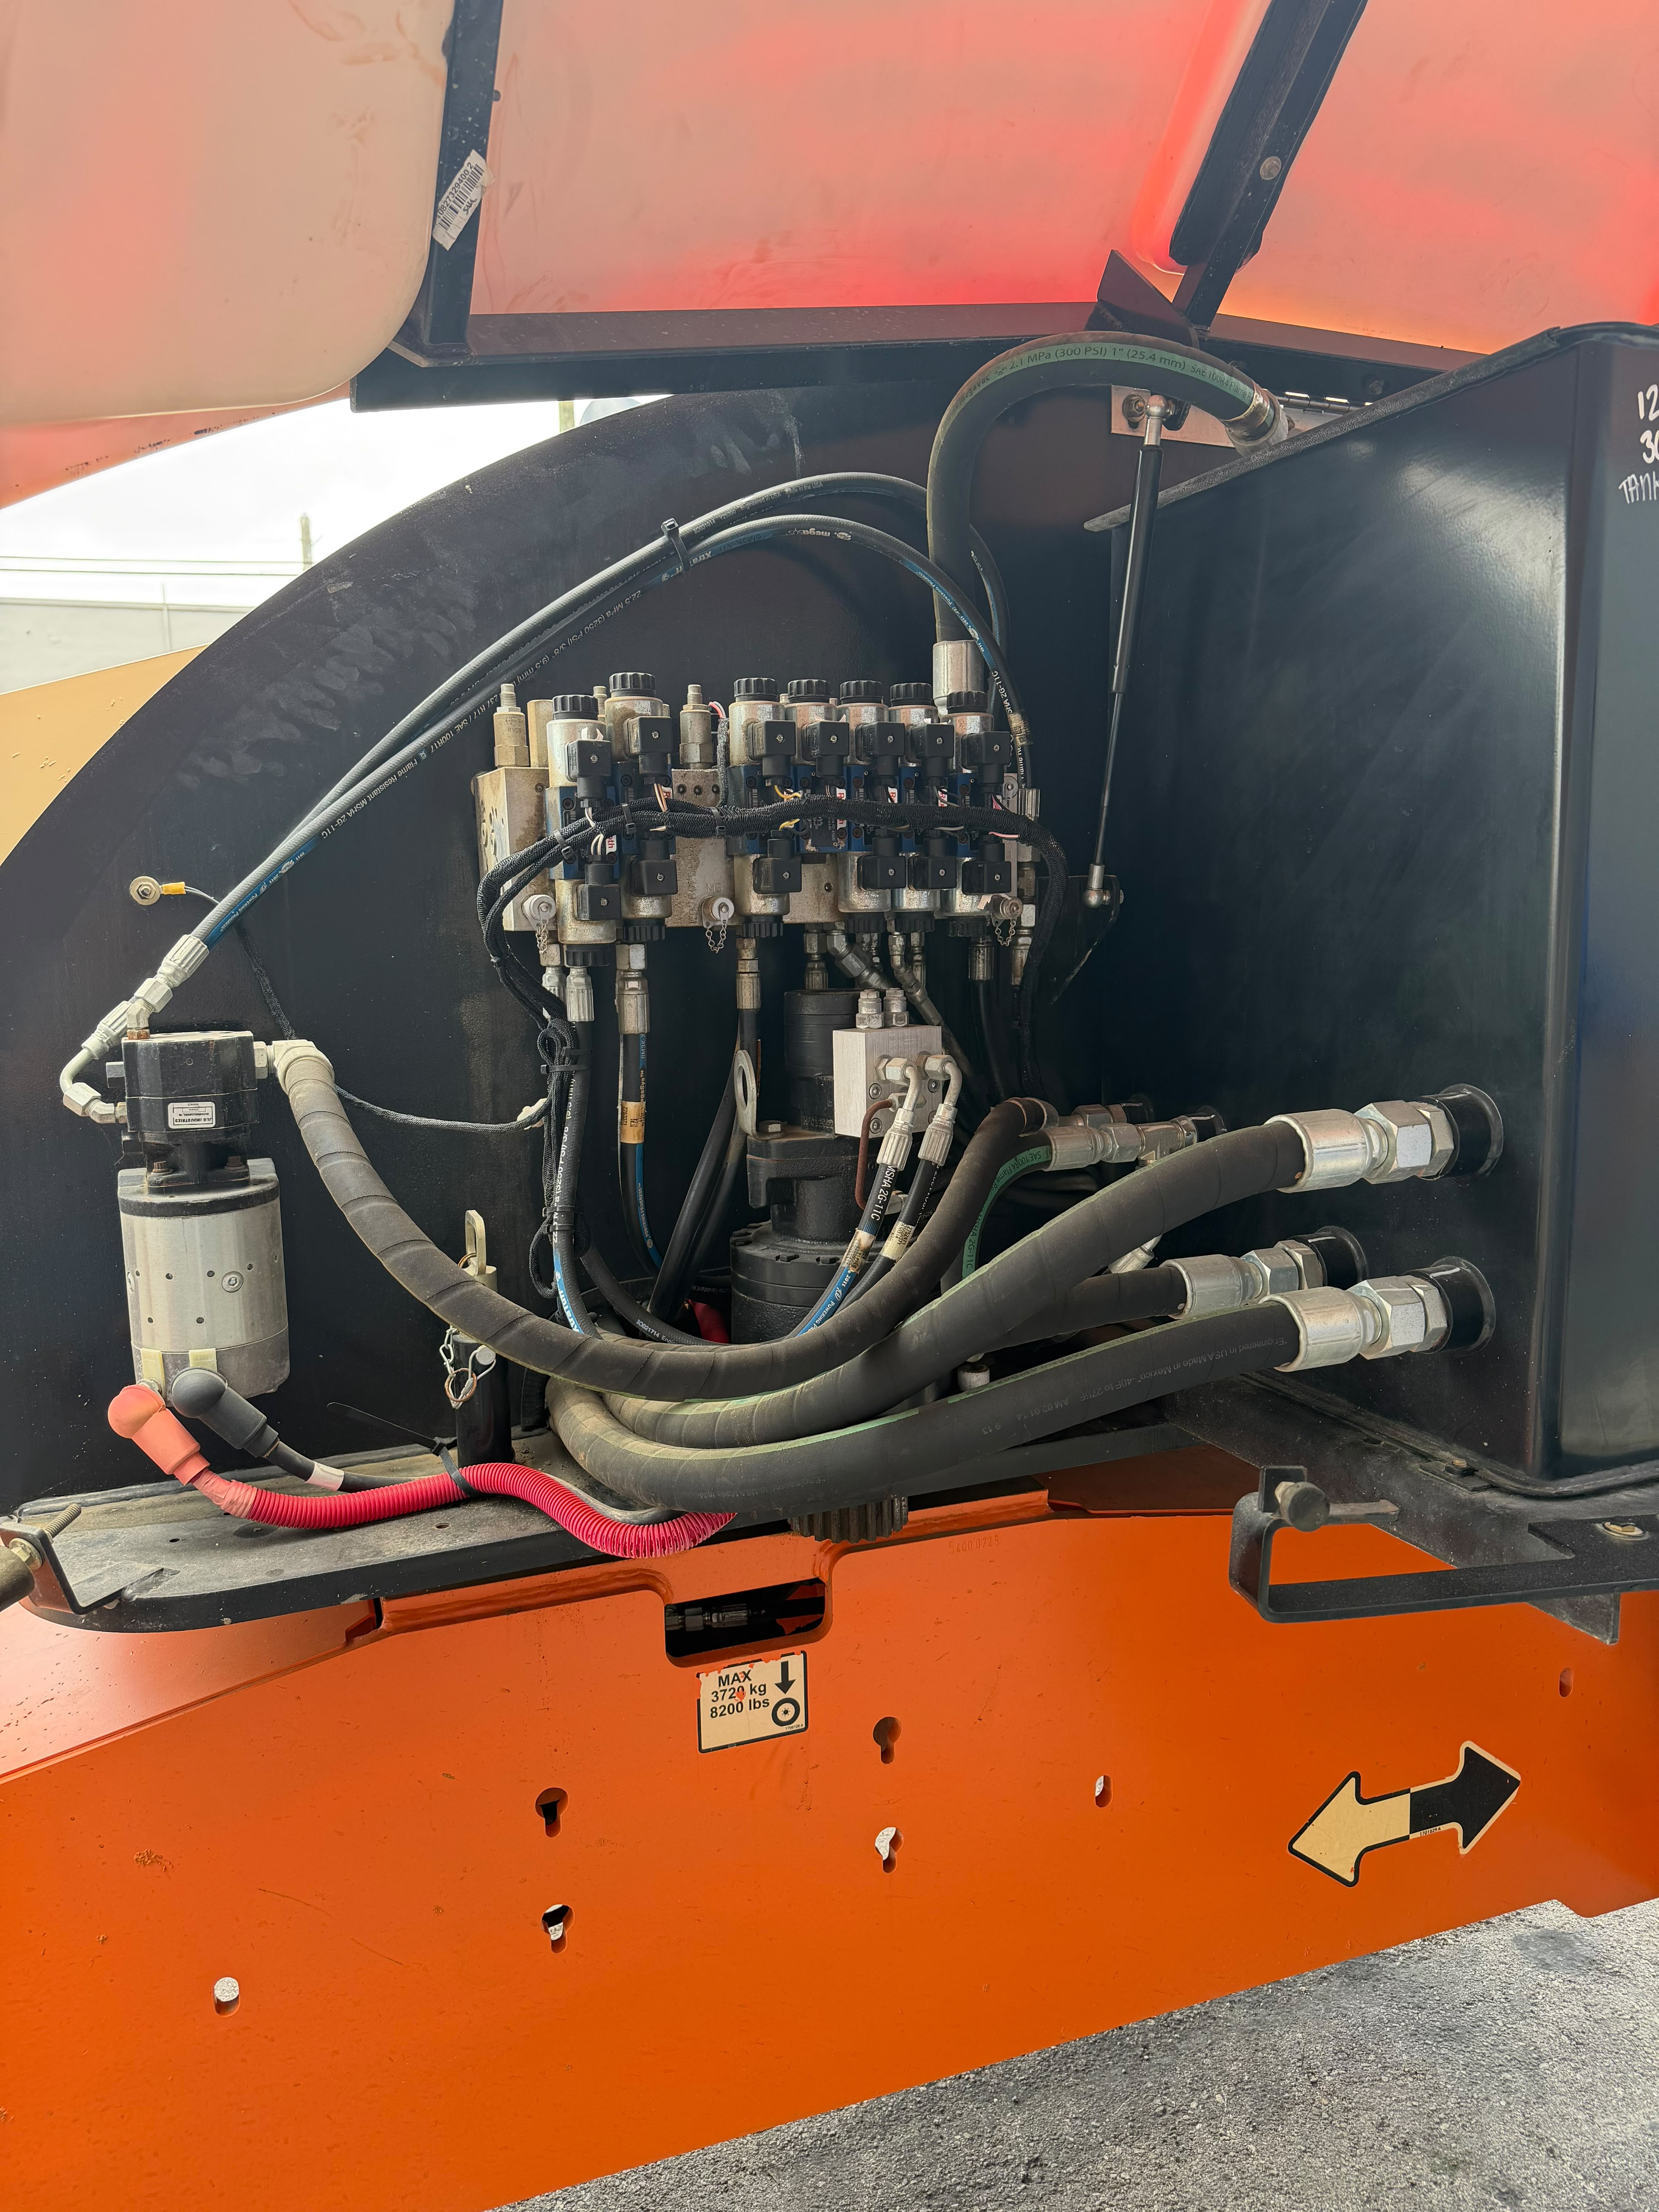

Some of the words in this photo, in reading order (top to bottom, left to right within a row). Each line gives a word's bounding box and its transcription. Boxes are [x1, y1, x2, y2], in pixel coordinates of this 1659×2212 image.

[1027, 351, 1051, 363] MPa
[1055, 347, 1081, 359] (300
[1084, 346, 1107, 358] PSI)
[1127, 349, 1156, 362] (25.4
[1160, 357, 1185, 371] mm)
[1191, 364, 1207, 377] SAE
[1230, 382, 1247, 398] Flame
[628, 589, 642, 604] 22.5
[606, 601, 624, 618] MPa
[584, 613, 606, 634] (3250
[567, 630, 584, 647] PSI)
[534, 655, 550, 670] (9.5
[992, 671, 1008, 700] 2G-11C
[473, 704, 486, 719] R17
[454, 719, 469, 734] SAE
[429, 729, 454, 753] 100R17
[397, 757, 418, 779] Flame
[366, 775, 398, 802] Resistant
[346, 798, 368, 818] MSHA
[321, 815, 347, 839] 2G-11C
[1029, 1150, 1042, 1162] SAE
[870, 1187, 889, 1221] 2G-11C
[965, 1236, 976, 1270] 2G-11C
[842, 1274, 851, 1287] 2011
[815, 1300, 836, 1324] POWERING
[1183, 1353, 1207, 1368] Made
[1209, 1348, 1229, 1361] USA
[718, 1669, 752, 1688] MAX
[749, 1683, 767, 1696] kg
[710, 1701, 744, 1719] 8200
[748, 1698, 770, 1711] lbs
